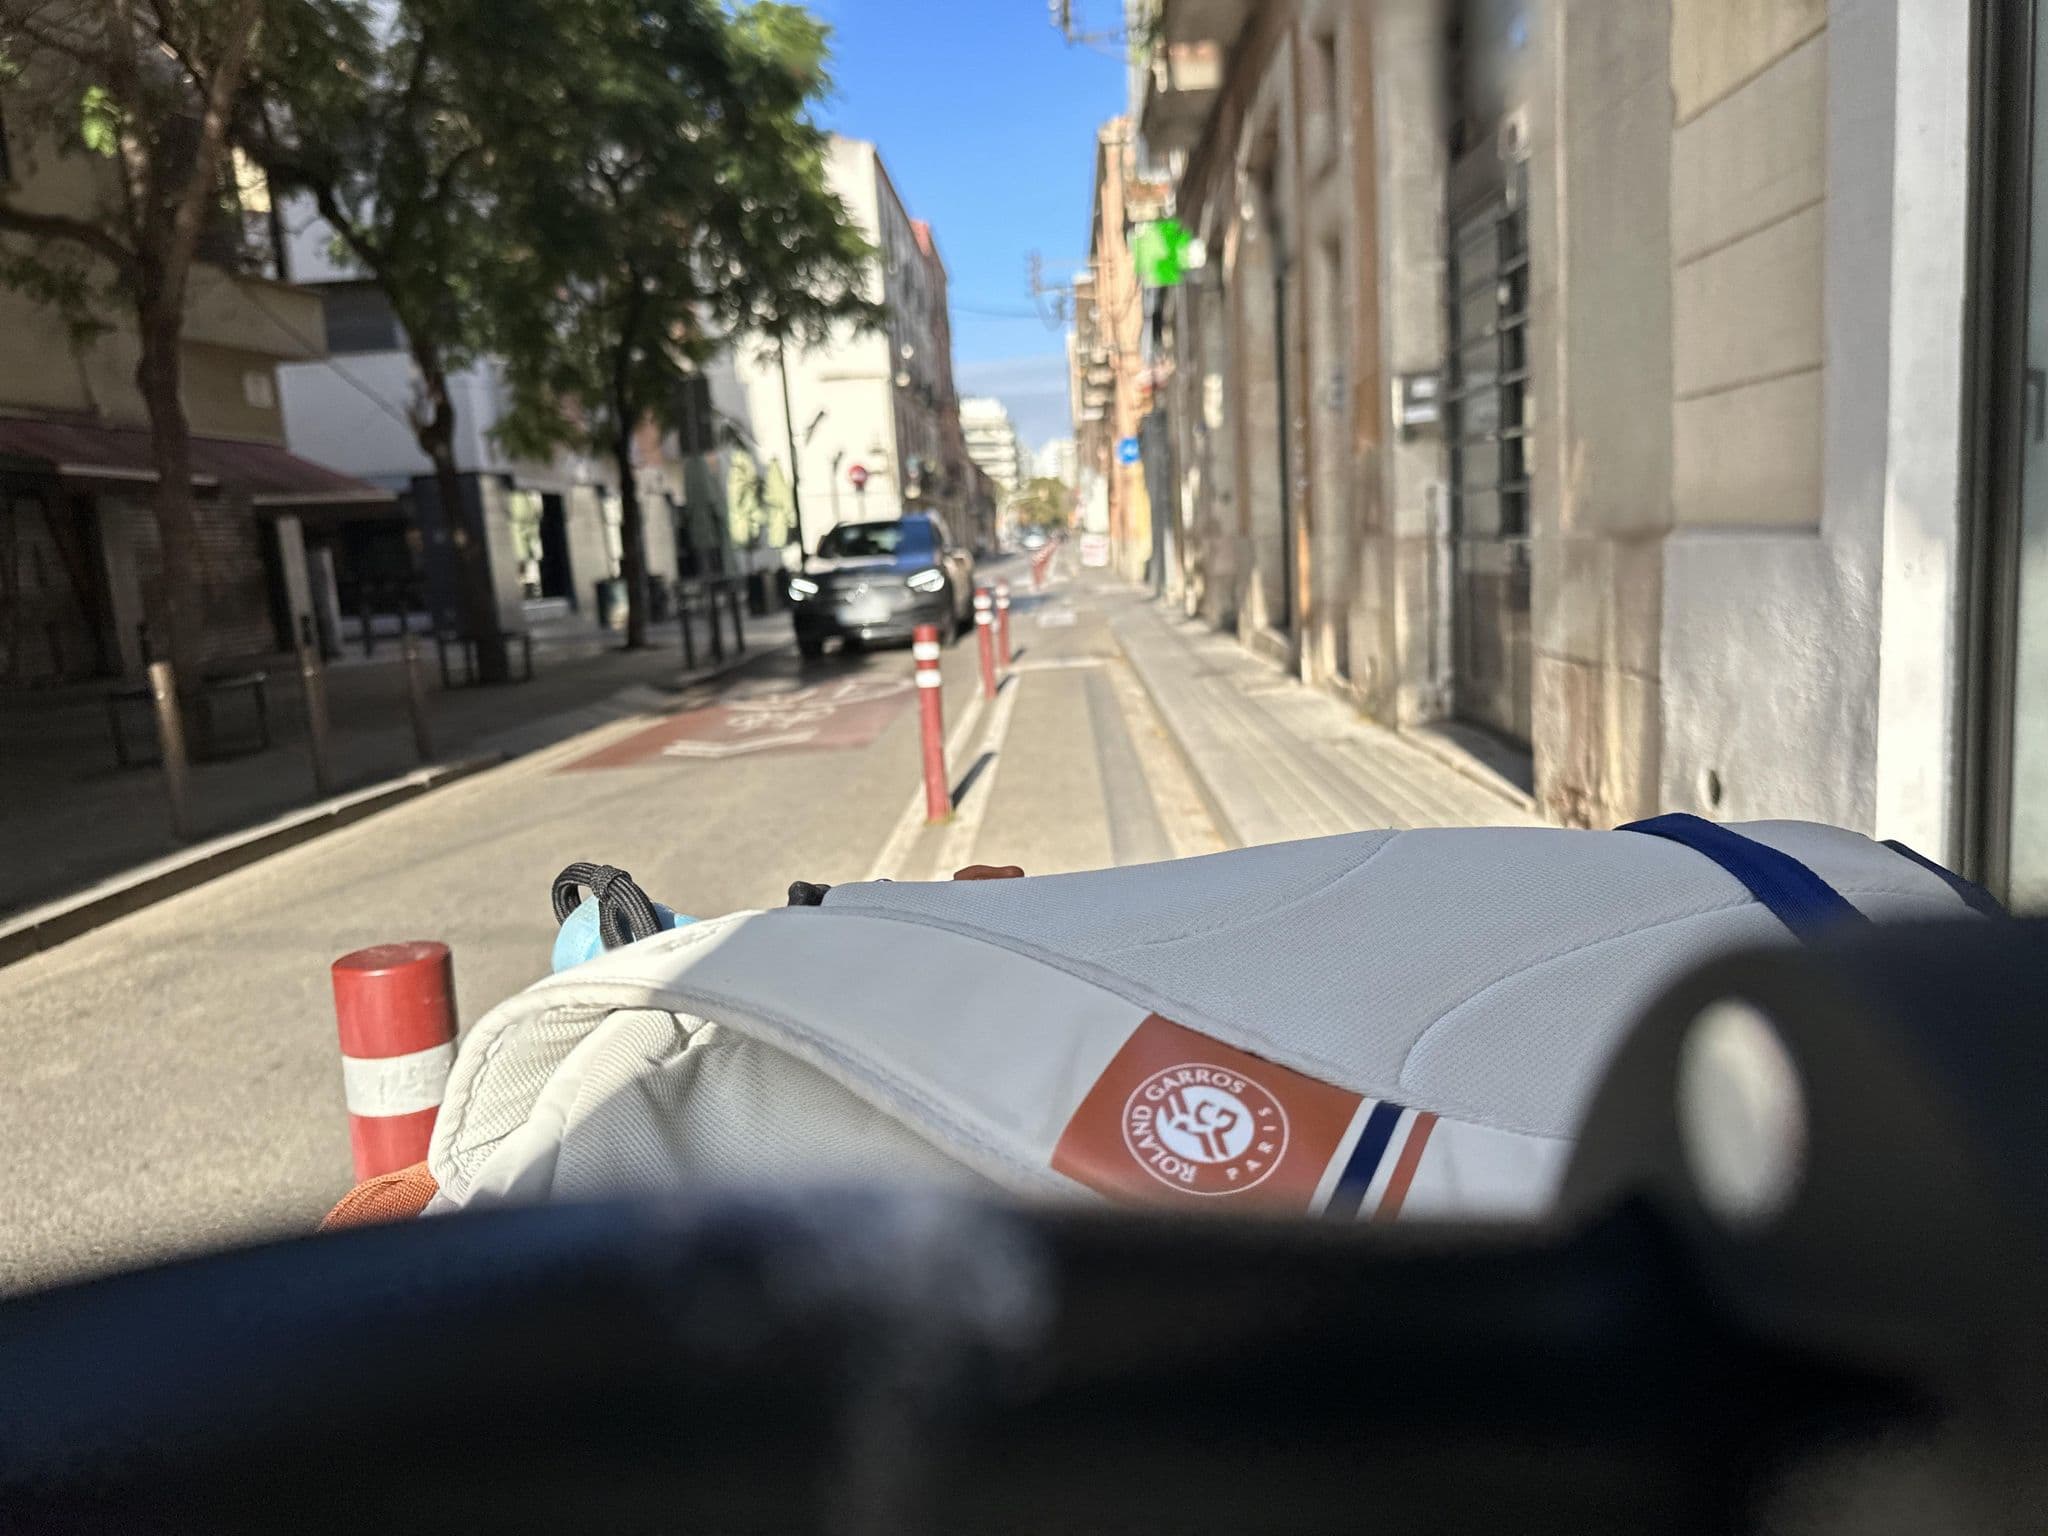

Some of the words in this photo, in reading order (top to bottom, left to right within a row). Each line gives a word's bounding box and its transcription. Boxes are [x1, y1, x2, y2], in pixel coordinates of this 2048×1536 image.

[1145, 1069, 1247, 1101] GARROS
[1131, 1105, 1197, 1183] ROLAND
[1226, 1107, 1277, 1181] PARIS
